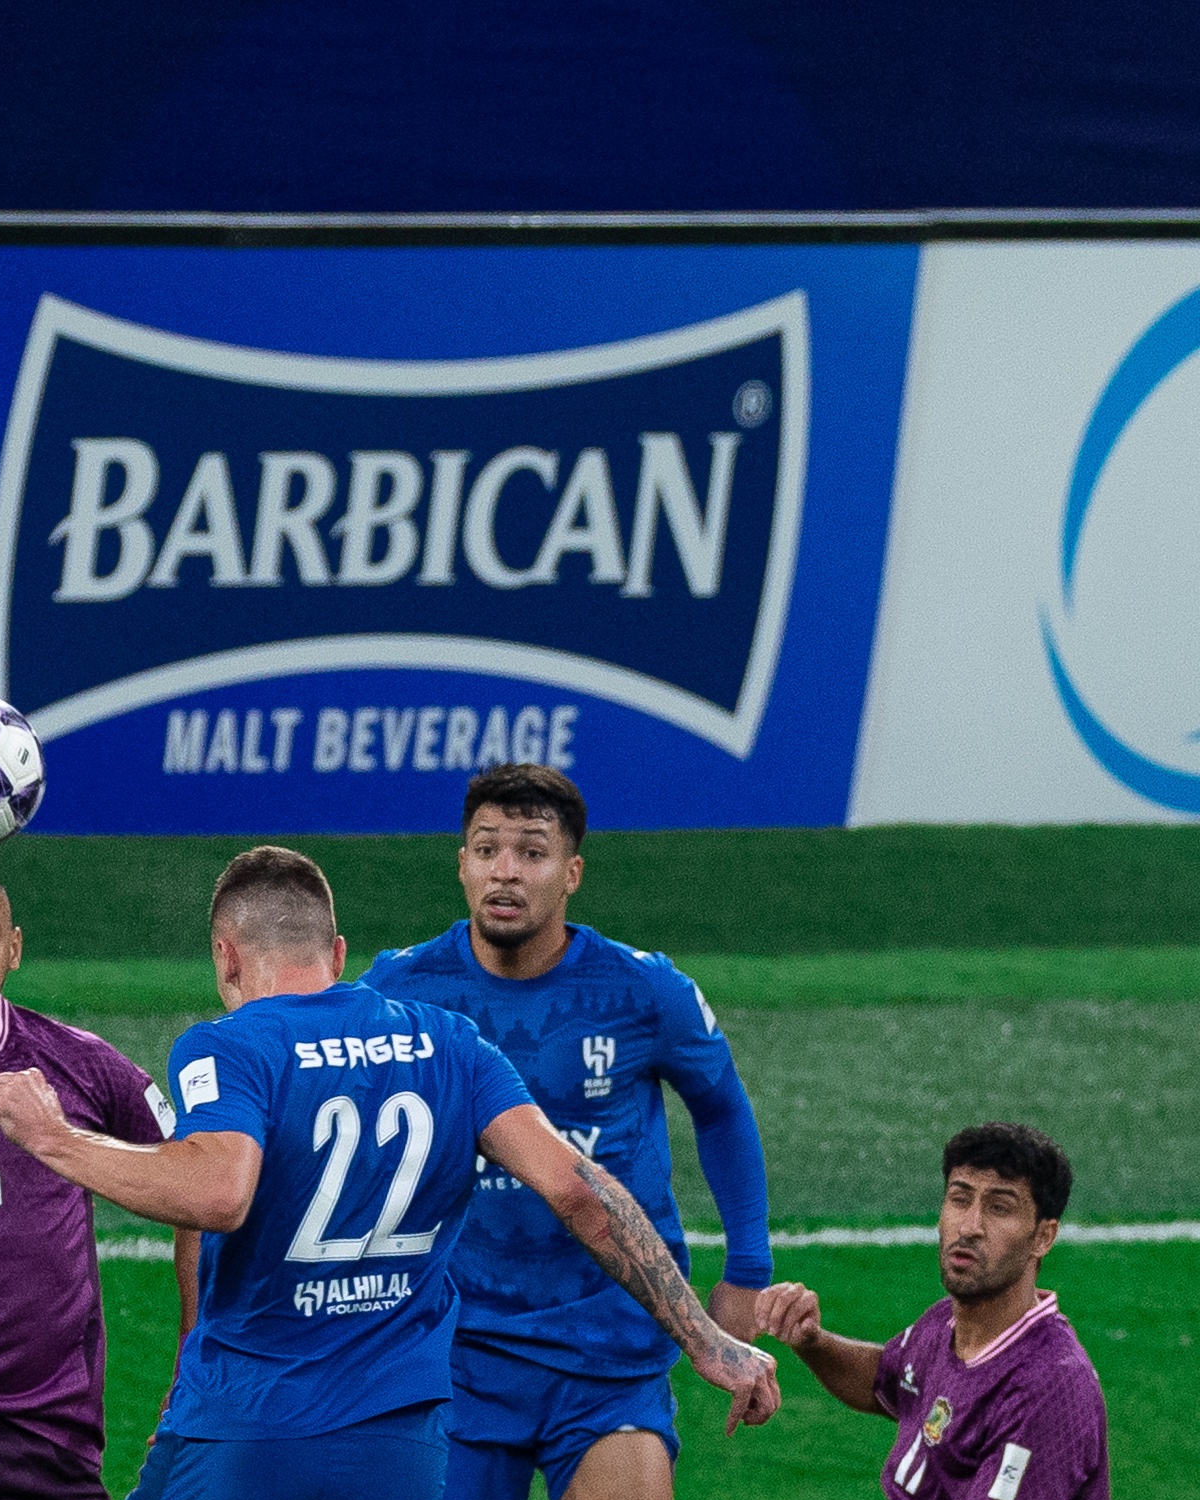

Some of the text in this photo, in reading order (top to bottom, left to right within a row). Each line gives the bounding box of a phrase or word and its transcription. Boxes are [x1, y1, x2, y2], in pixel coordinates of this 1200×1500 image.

[48, 430, 743, 603] BARBICAN
[163, 704, 580, 774] MALT BEVERAGE
[295, 1032, 434, 1070] SERGEJ
[284, 1091, 443, 1263] 22
